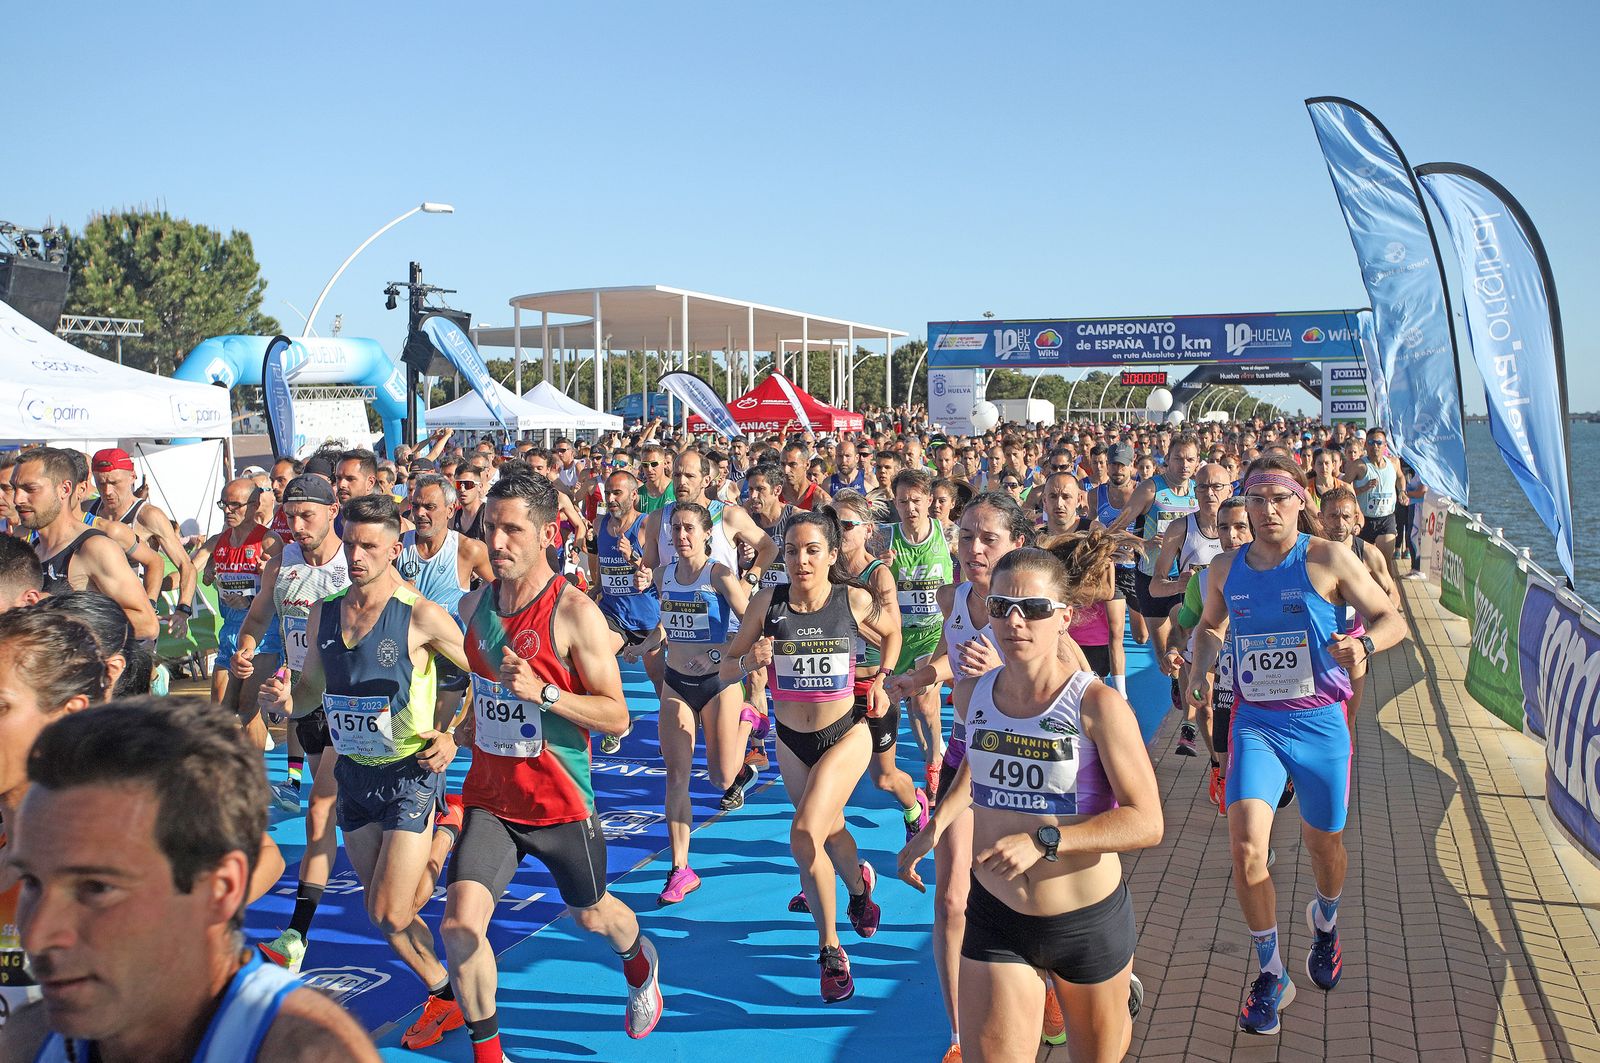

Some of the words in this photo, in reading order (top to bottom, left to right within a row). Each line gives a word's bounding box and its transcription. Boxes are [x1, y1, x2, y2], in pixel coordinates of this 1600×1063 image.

[1076, 321, 1176, 335] CAMPEONATO
[1250, 328, 1292, 342] HUELVA
[1327, 328, 1359, 341] WiH
[1076, 340, 1092, 351] de
[1094, 336, 1144, 350] ESPAÑA
[1152, 335, 1176, 351] 10
[1181, 333, 1212, 350] km
[308, 345, 347, 365] HUELVA
[1037, 349, 1059, 357] WiHu
[1141, 350, 1176, 359] Absoluto
[1177, 351, 1183, 360] y
[1184, 350, 1212, 358] Master
[608, 576, 629, 586] 266
[911, 591, 936, 604] 193
[669, 614, 694, 628] 419
[1280, 636, 1301, 646] 2023
[792, 656, 832, 675] 416
[1248, 650, 1298, 671] 1629
[361, 701, 382, 711] 2023
[478, 697, 527, 724] 1894
[333, 712, 379, 733] 1576
[1005, 734, 1059, 750] RUNNING
[1017, 749, 1050, 759] LOOP
[989, 758, 1044, 790] 490
